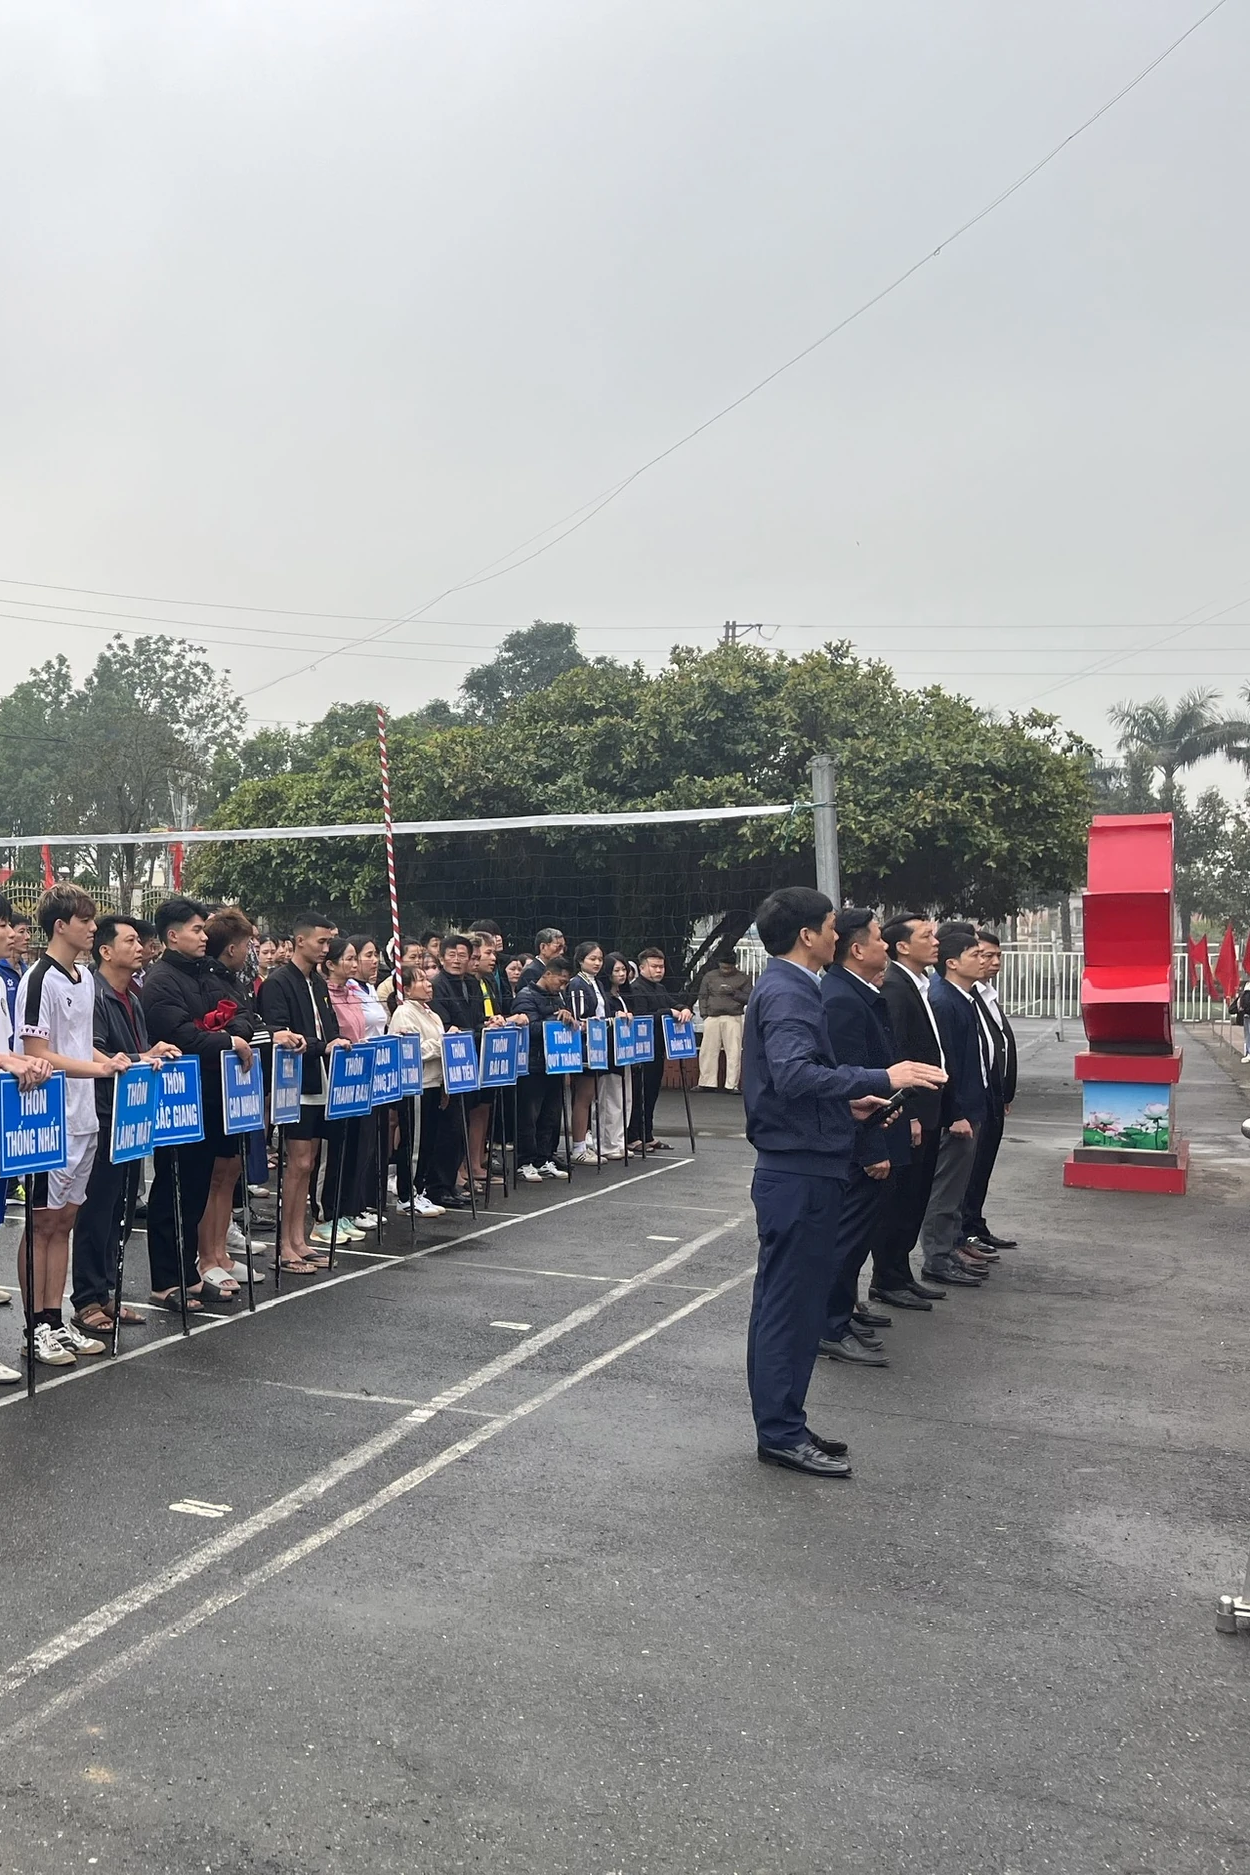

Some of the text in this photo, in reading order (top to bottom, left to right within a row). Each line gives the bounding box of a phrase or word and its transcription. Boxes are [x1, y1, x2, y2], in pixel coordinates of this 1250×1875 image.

[345, 1053, 364, 1076] THÔN
[375, 1045, 391, 1066] OÀN
[127, 1077, 148, 1107] THÔN
[162, 1066, 186, 1095] THÔN
[19, 1086, 48, 1117] THÔN
[173, 1104, 198, 1128] GIANG
[5, 1117, 60, 1157] THỐNG NHẤT
[116, 1121, 135, 1151] LÀNG
